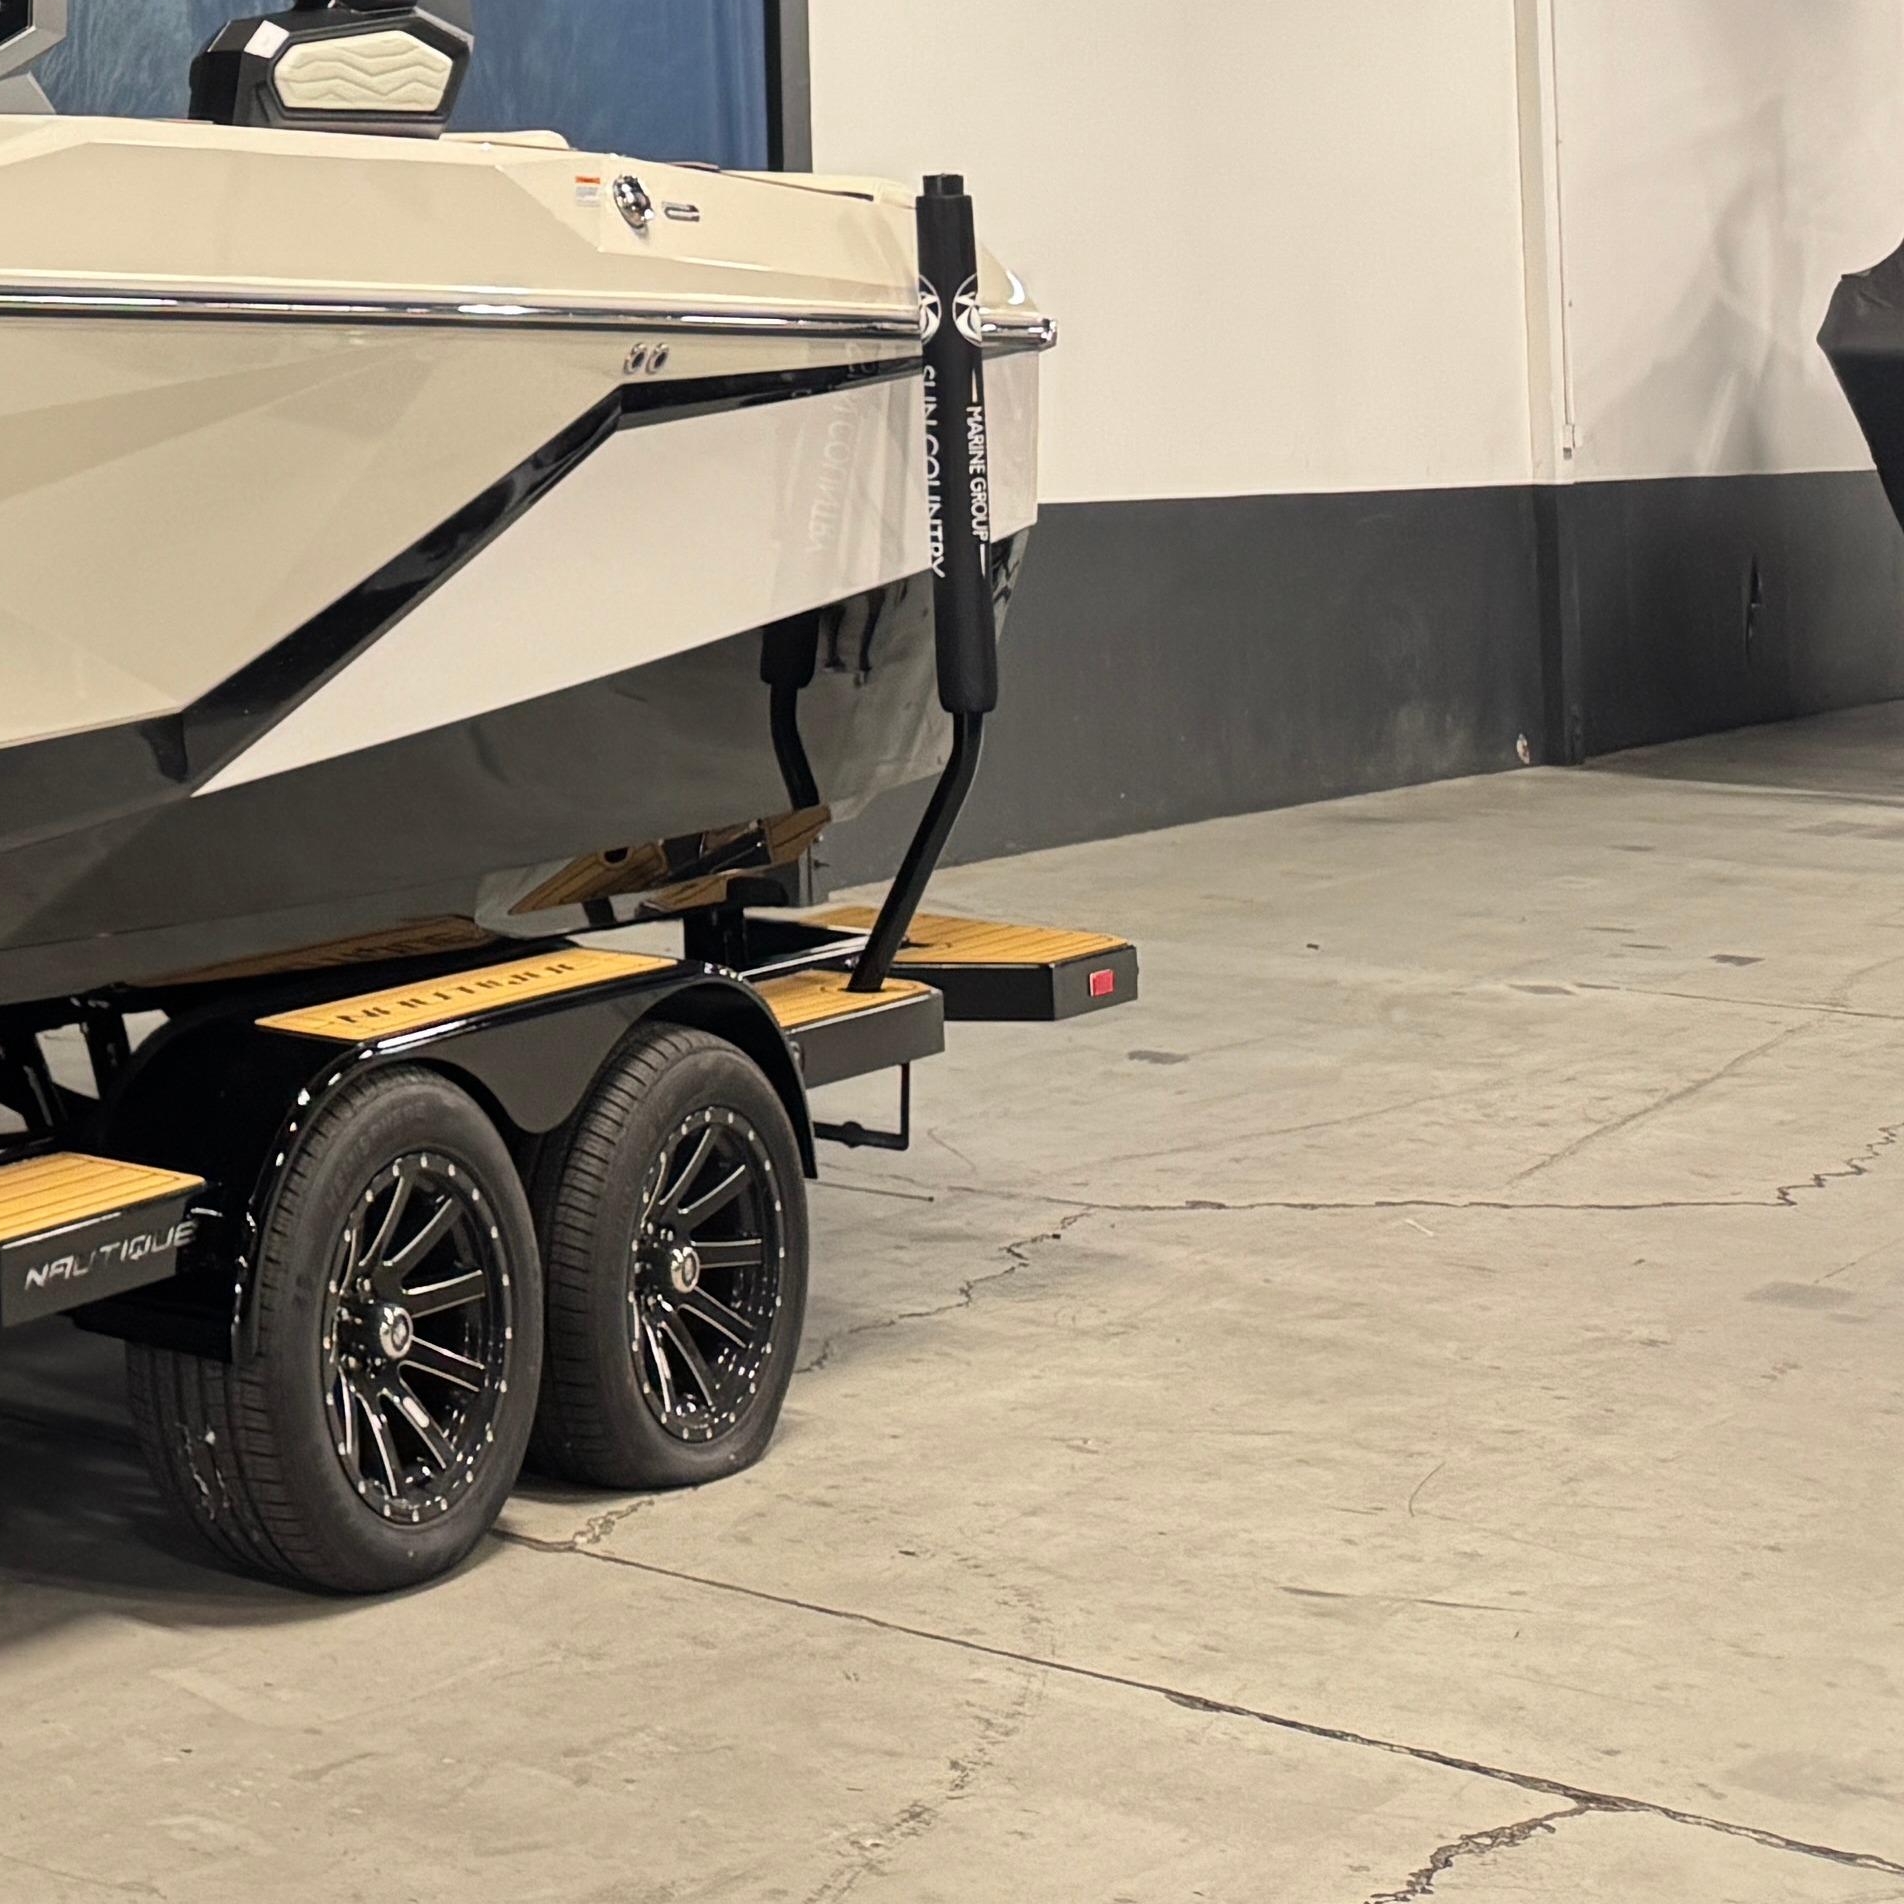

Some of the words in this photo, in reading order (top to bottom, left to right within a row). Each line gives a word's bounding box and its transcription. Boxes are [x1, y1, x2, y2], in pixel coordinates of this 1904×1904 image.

[966, 406, 985, 475] MARINE
[970, 477, 989, 542] GROUP
[24, 1219, 198, 1291] NAUTIQUE
